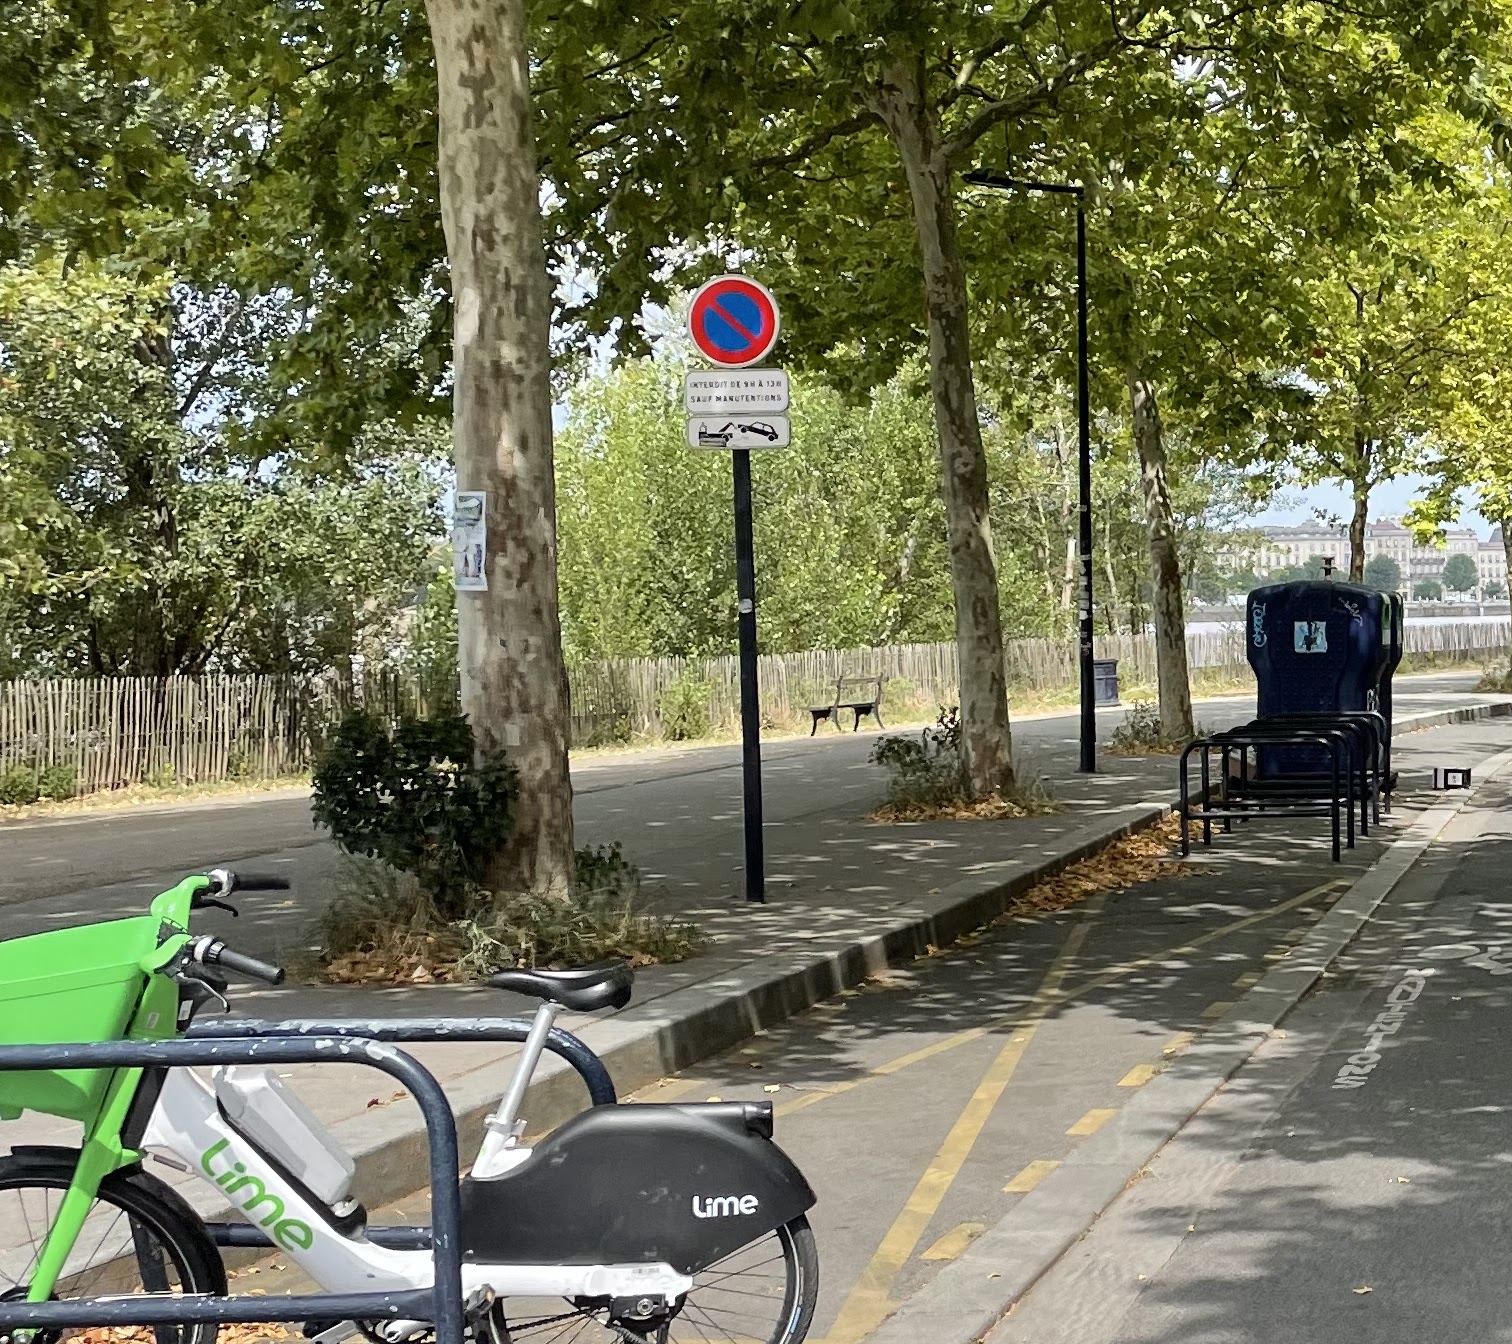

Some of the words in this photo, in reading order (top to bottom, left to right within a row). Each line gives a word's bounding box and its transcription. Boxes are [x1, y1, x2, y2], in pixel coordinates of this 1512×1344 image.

[690, 395, 712, 403] SAUF
[715, 394, 782, 402] MANUTENTIONS
[201, 1137, 313, 1251] Lime
[692, 1194, 759, 1218] Lime
